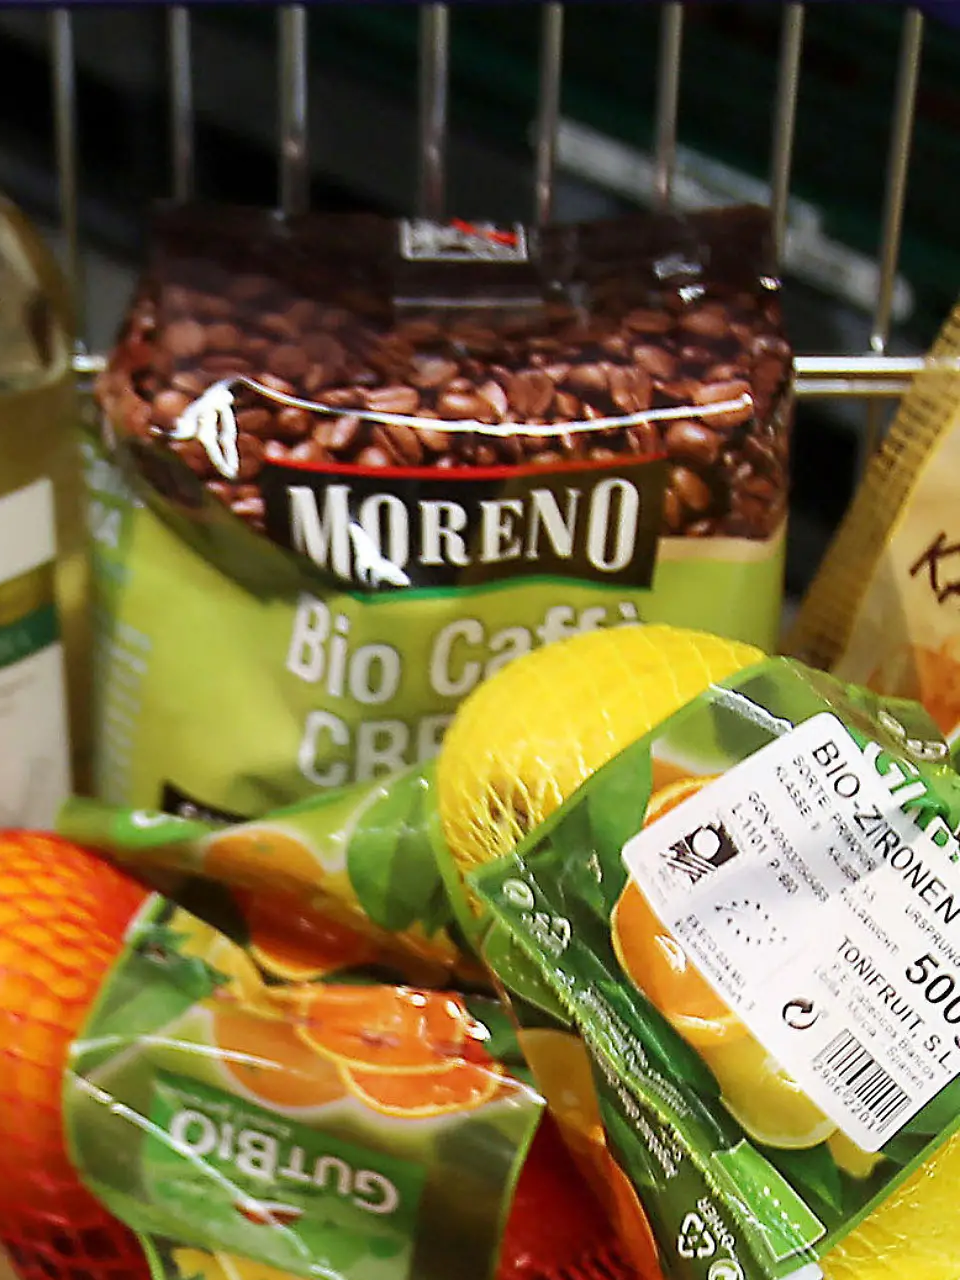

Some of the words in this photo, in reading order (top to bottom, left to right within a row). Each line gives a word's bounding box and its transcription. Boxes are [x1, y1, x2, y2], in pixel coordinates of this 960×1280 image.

[287, 477, 639, 580] MORENO
[286, 591, 401, 703] Bio
[834, 935, 925, 1038] TOÑIFRUIT,
[921, 1033, 954, 1076] S.L.
